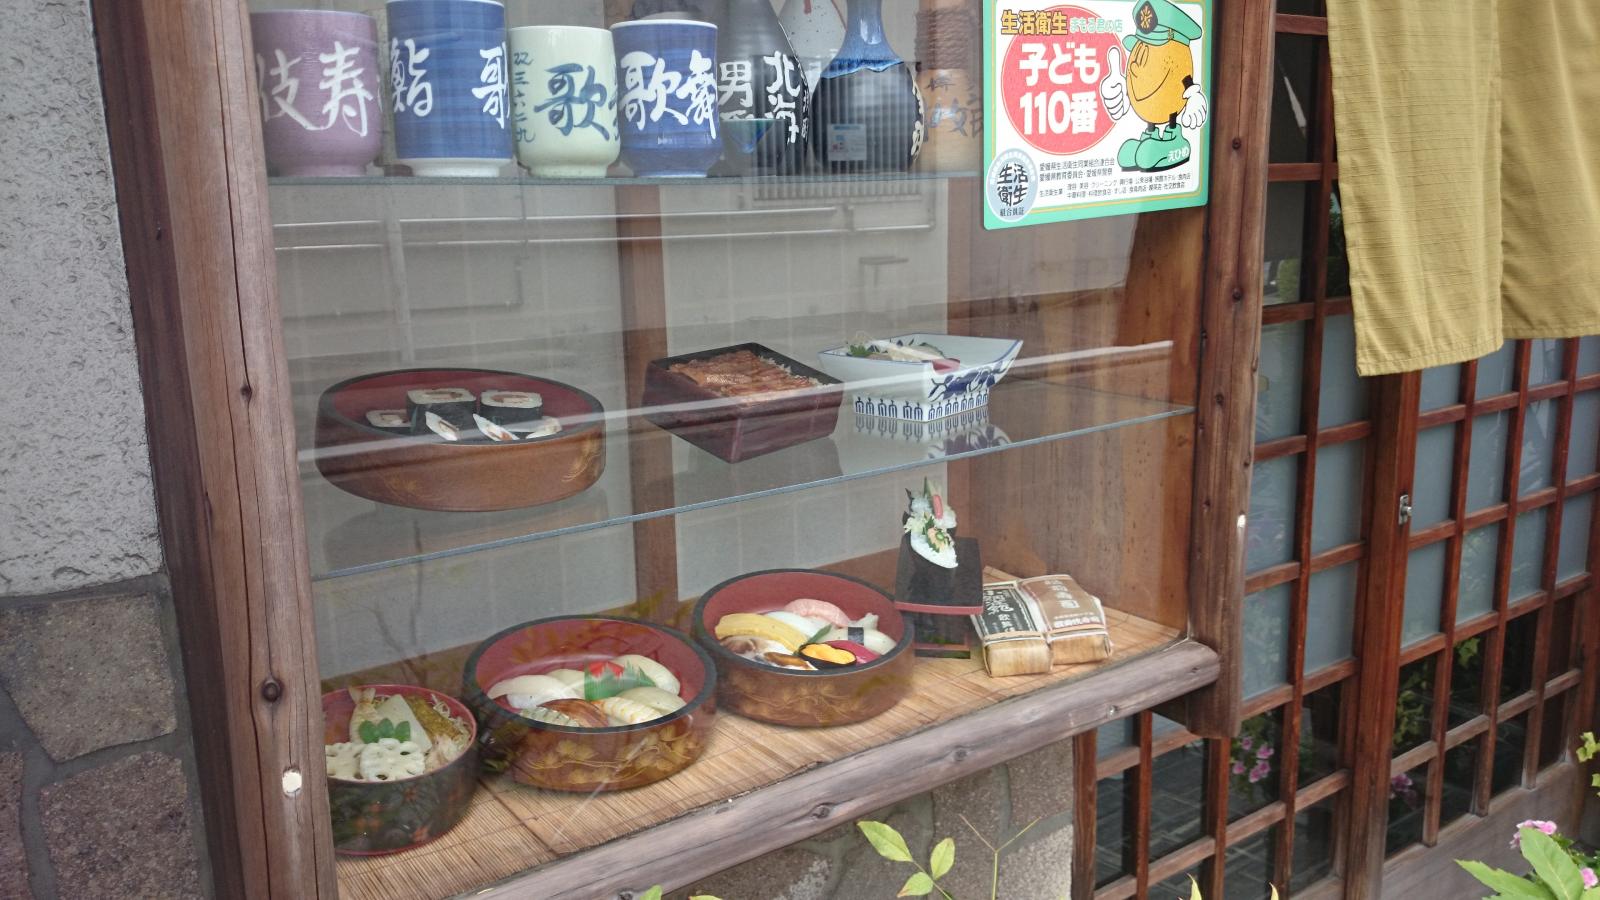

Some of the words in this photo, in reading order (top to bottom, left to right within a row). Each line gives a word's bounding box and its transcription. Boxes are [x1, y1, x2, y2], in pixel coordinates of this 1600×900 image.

[1001, 9, 1069, 36] 生活衛生
[1019, 42, 1101, 87] 子ども
[1019, 90, 1098, 135] 110番
[1167, 147, 1190, 164] えひめ
